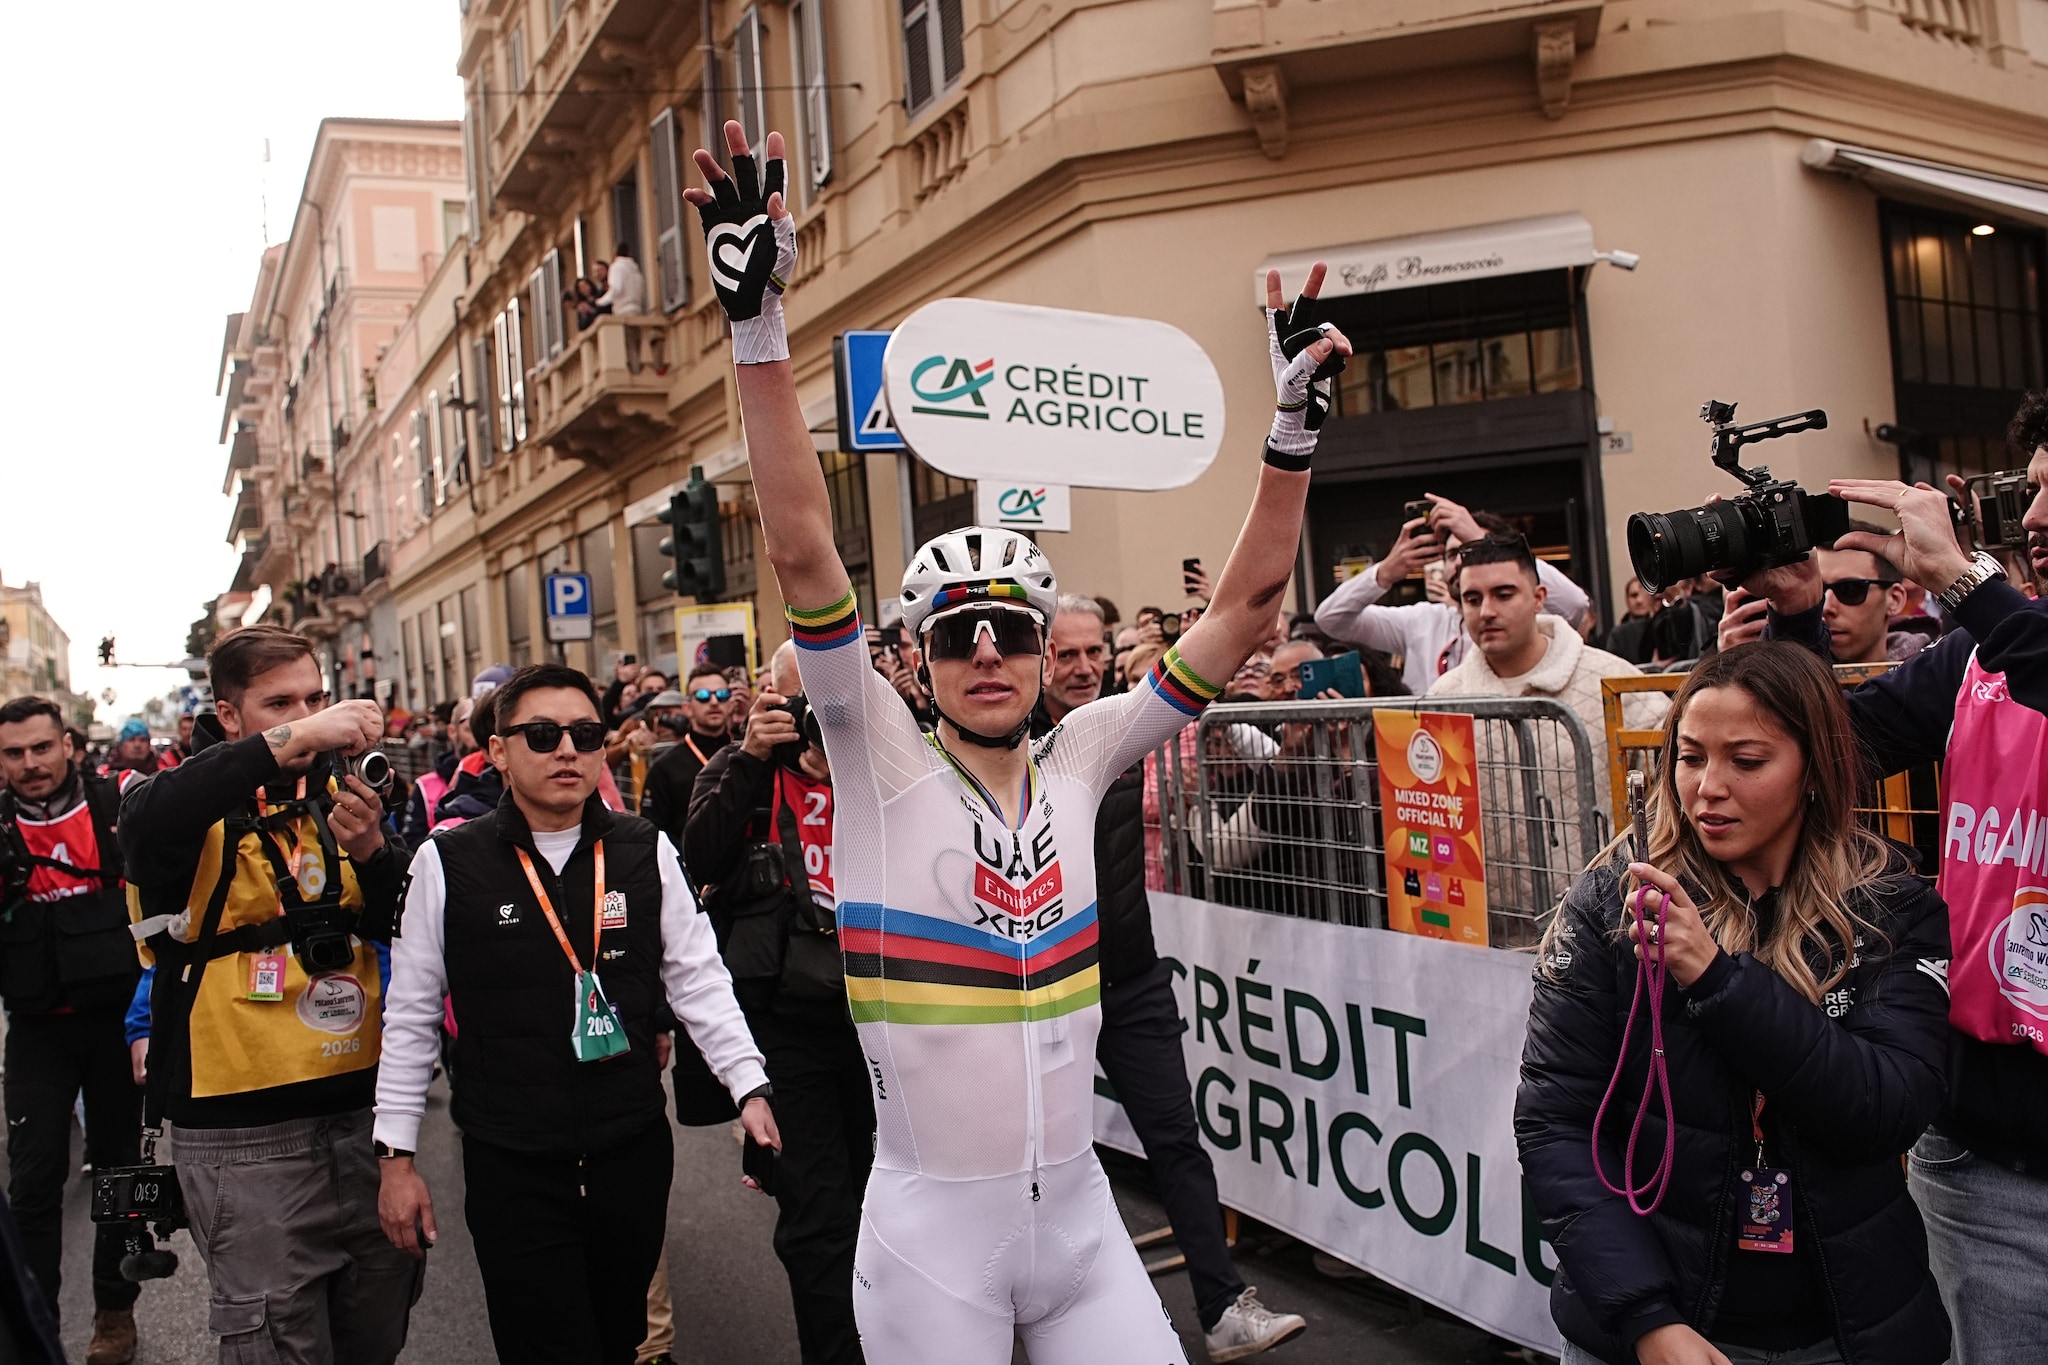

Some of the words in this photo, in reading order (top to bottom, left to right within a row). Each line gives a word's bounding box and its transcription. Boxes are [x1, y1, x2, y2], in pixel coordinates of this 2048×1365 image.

[1339, 264, 1388, 292] Caffè
[1396, 252, 1504, 281] Brancaccio
[1004, 363, 1149, 402] CRÉDIT
[1006, 397, 1205, 439] AGRICOLE
[1024, 543, 1041, 568] ME
[553, 577, 584, 614] P
[802, 792, 827, 826] 2
[1394, 788, 1430, 807] MIXED
[1431, 793, 1463, 812] ZONE
[1396, 806, 1447, 828] OFFICIAL
[1447, 814, 1464, 830] TV
[973, 820, 1057, 882] UAE
[1409, 836, 1429, 854] MZ
[973, 898, 1064, 940] XRG
[2023, 976, 2048, 991] AGRICO
[587, 1014, 615, 1037] 206
[2012, 1022, 2045, 1043] 2026
[321, 1037, 360, 1058] 2026
[1195, 1065, 1561, 1290] GRICOL
